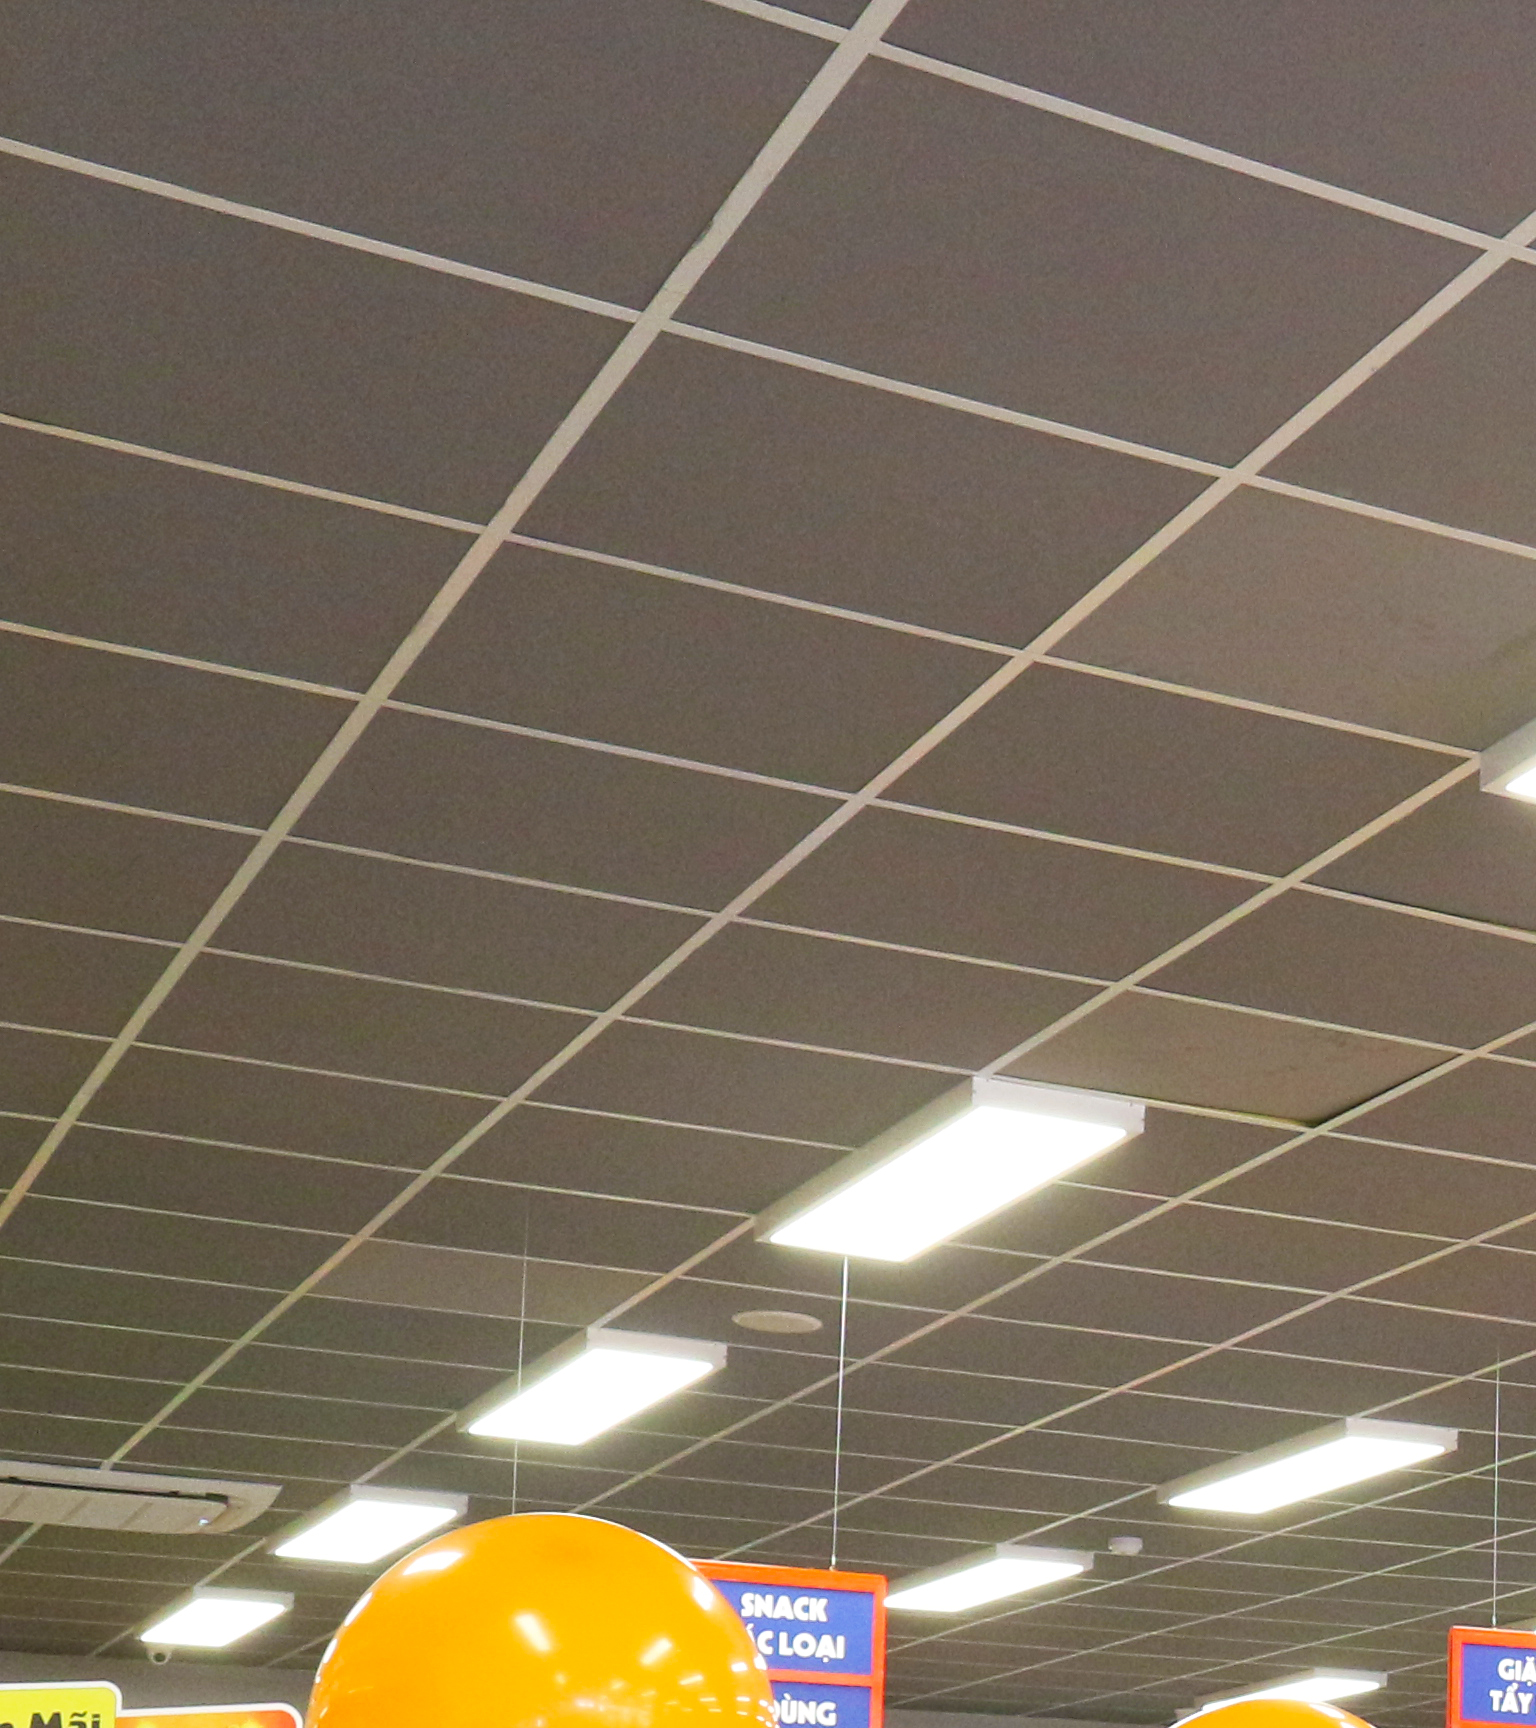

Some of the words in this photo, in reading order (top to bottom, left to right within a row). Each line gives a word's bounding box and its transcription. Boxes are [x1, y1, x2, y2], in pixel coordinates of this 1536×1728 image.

[741, 1593, 828, 1622] SNACK
[779, 1632, 845, 1663] LOẠI
[1490, 1683, 1533, 1714] TẨY
